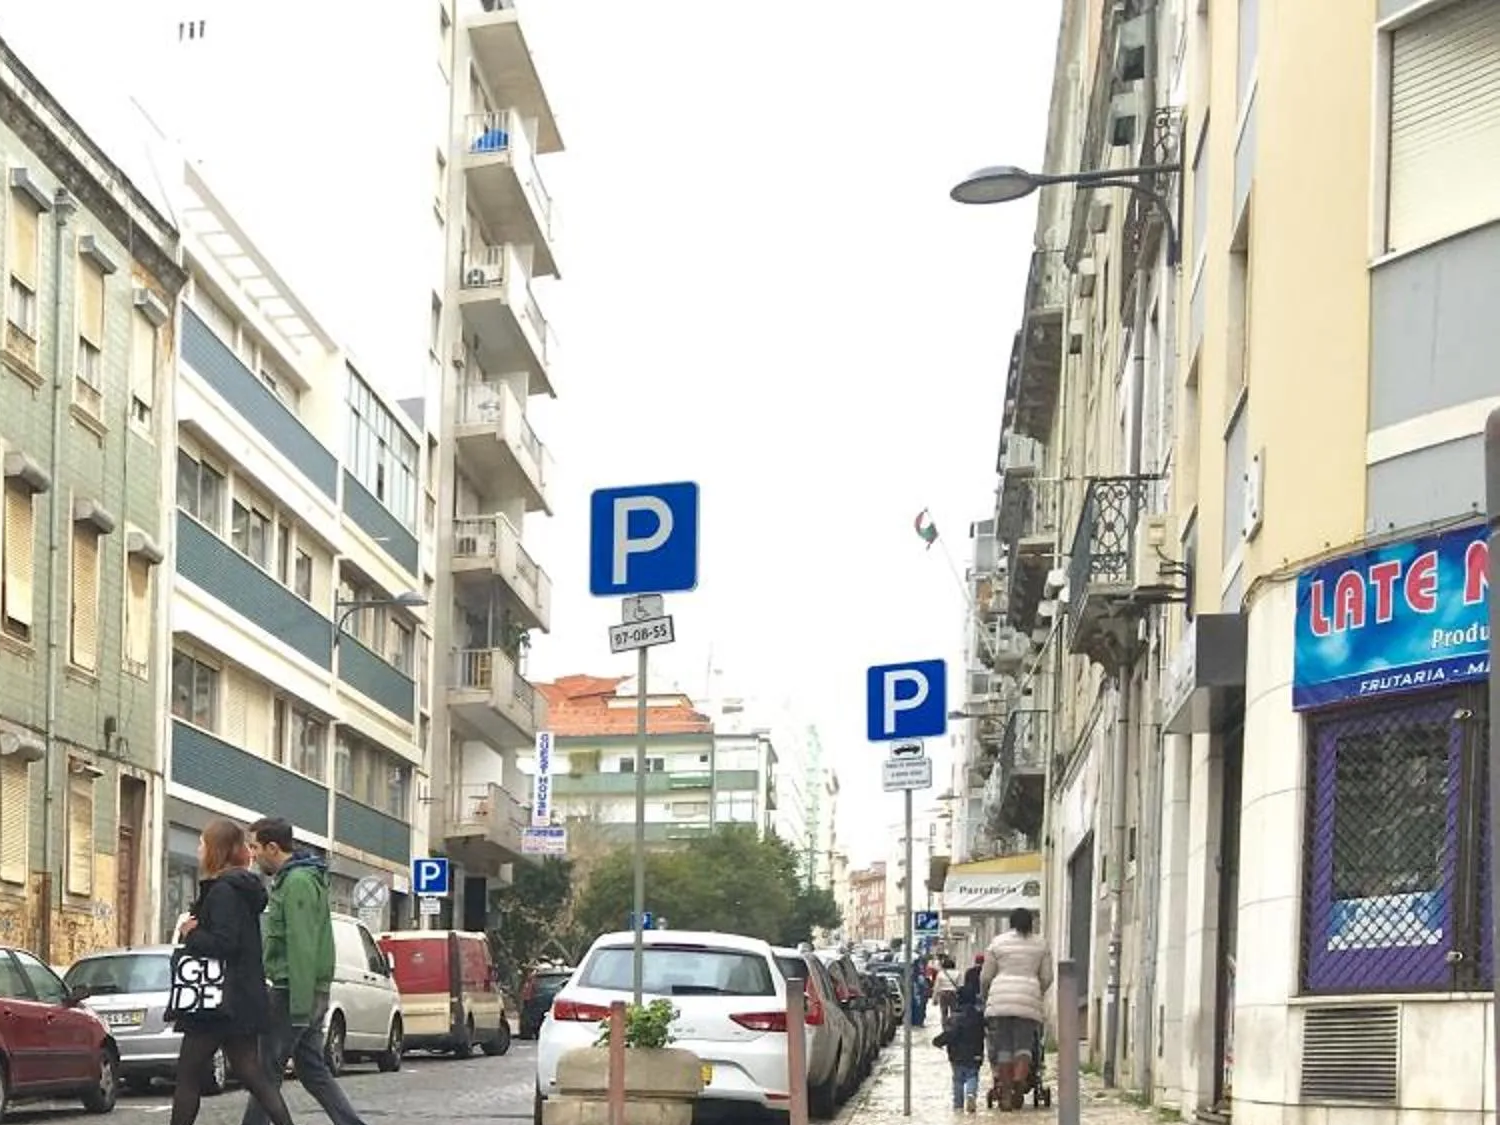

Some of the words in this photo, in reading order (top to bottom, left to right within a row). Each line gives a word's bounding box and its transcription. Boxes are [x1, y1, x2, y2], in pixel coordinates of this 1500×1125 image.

[612, 496, 674, 585] P
[1310, 550, 1439, 637] LATE
[884, 669, 929, 734] P
[1360, 667, 1446, 693] FRUTARIA
[421, 862, 440, 890] P
